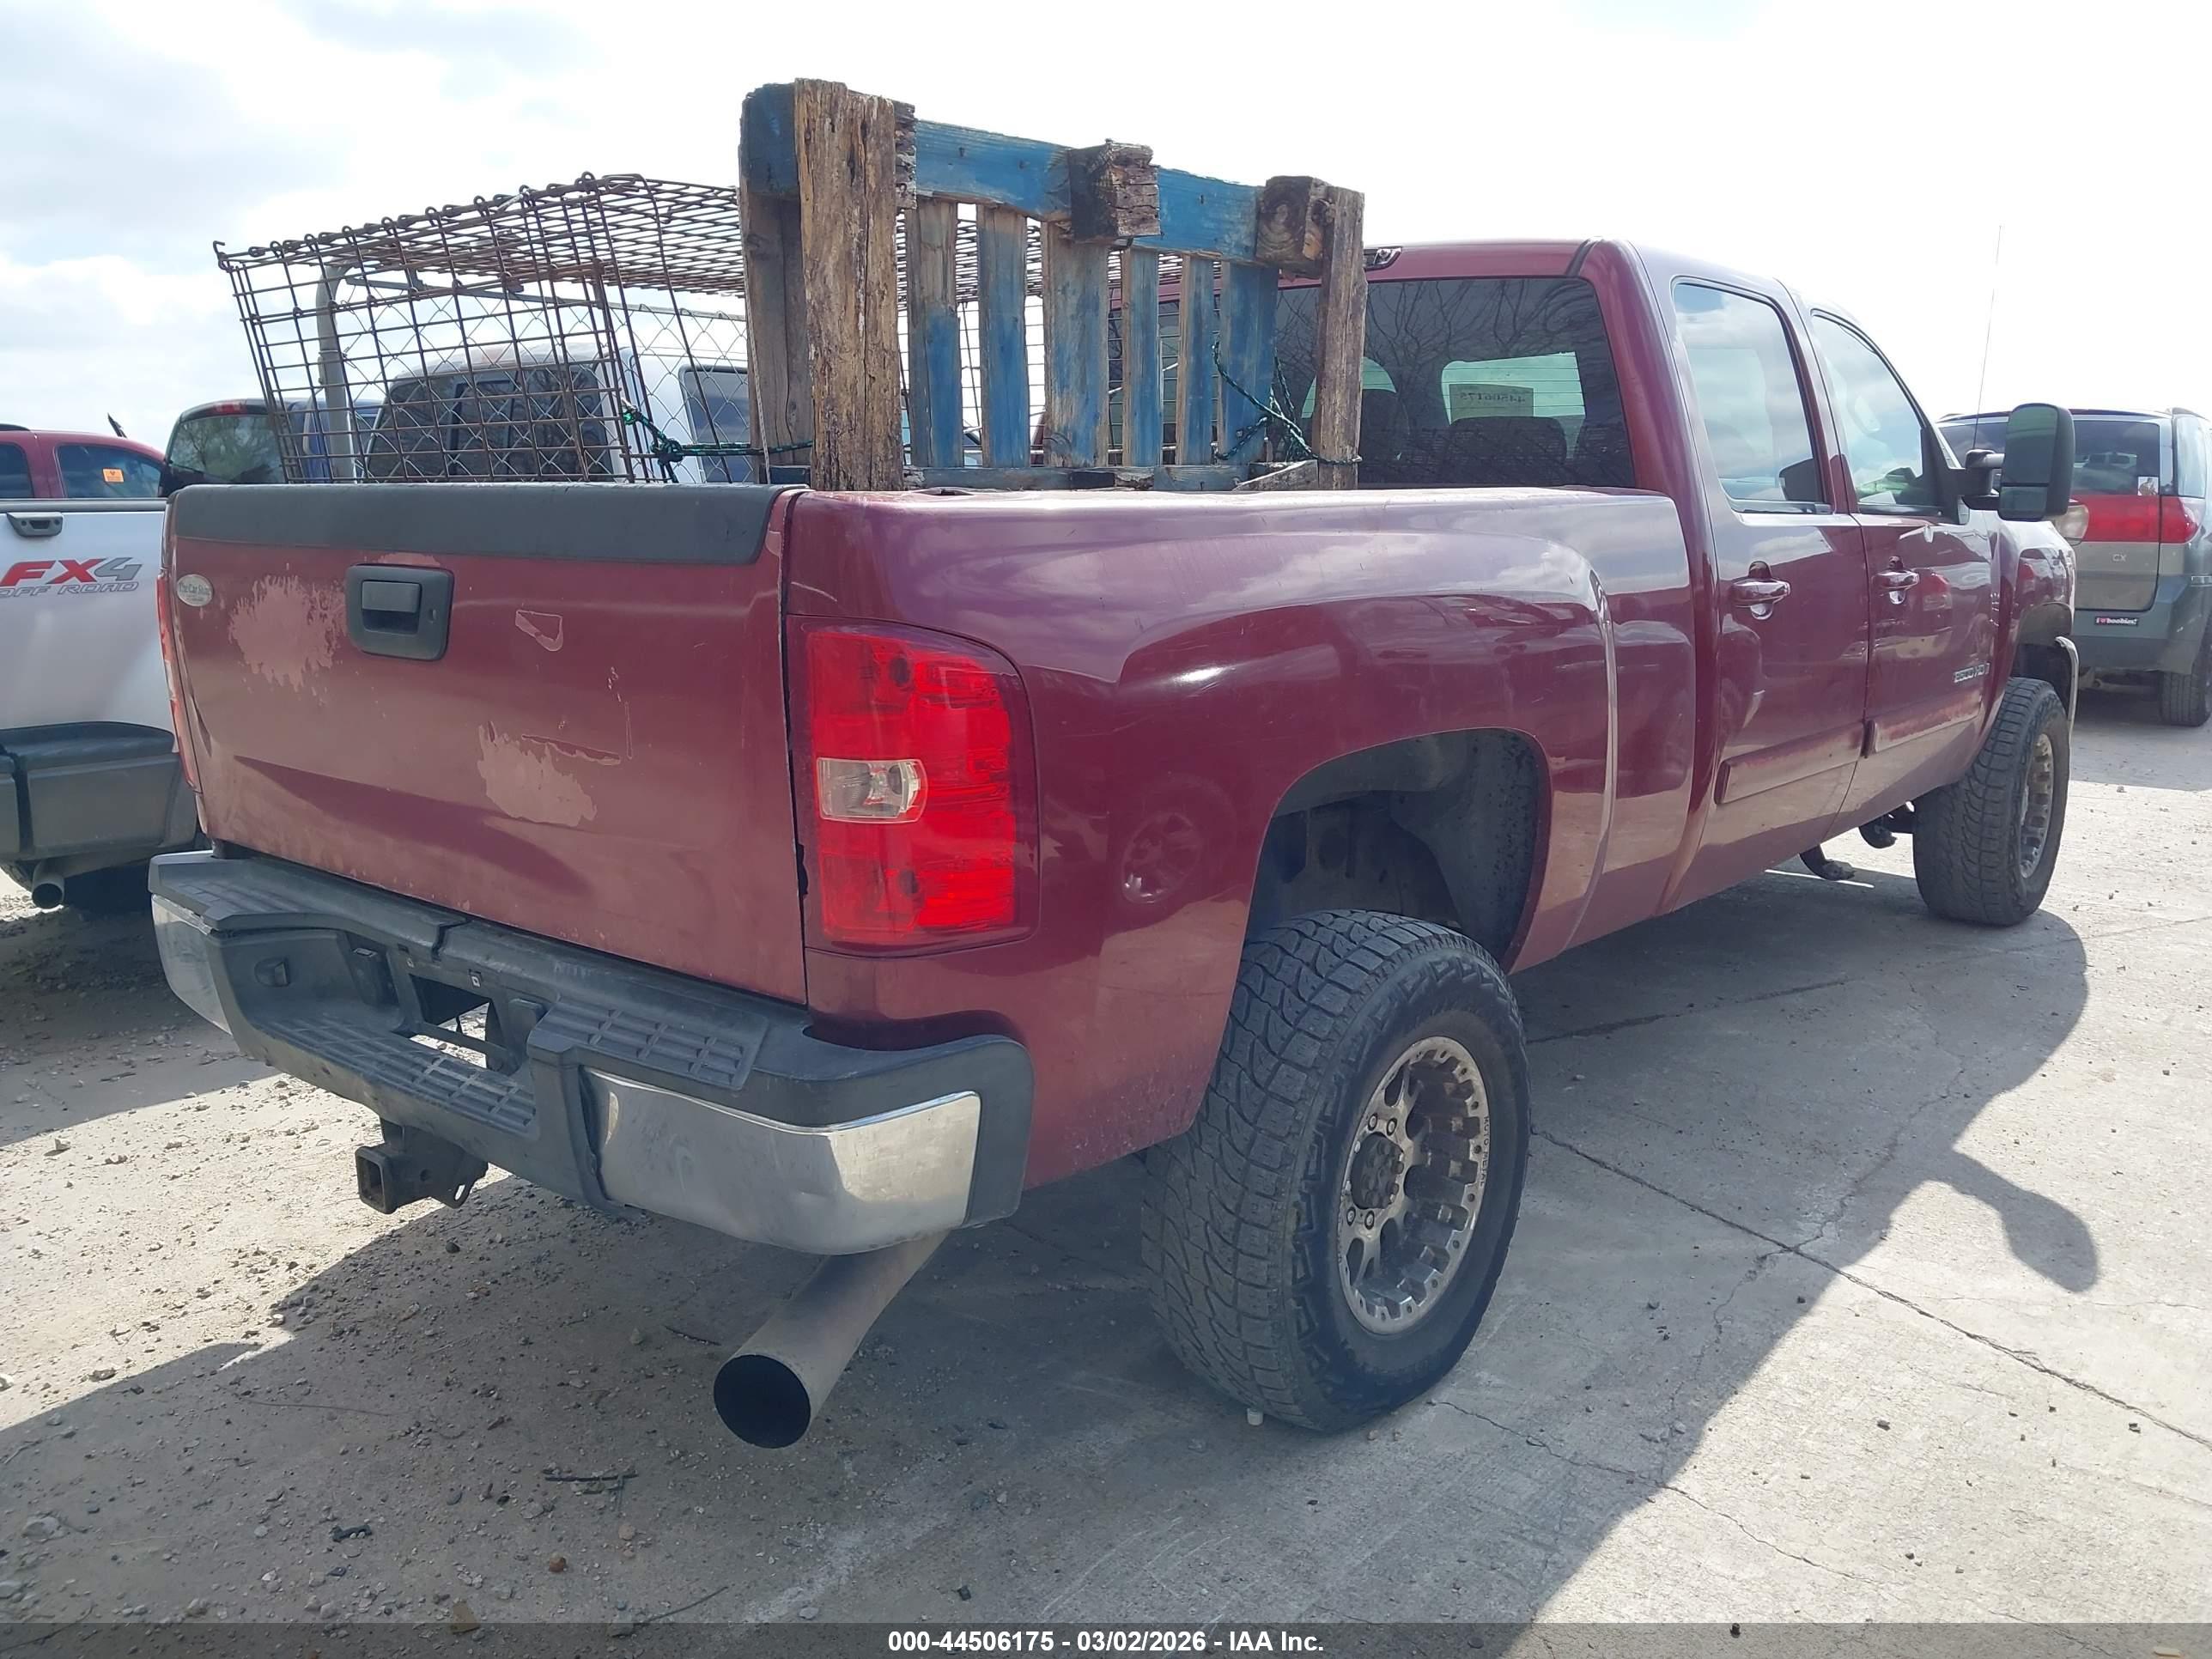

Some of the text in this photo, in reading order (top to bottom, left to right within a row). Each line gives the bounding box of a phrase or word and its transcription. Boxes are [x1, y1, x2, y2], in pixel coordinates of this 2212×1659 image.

[2112, 553, 2127, 562] CX
[0, 556, 143, 586] FX4
[58, 581, 139, 595] ROAD
